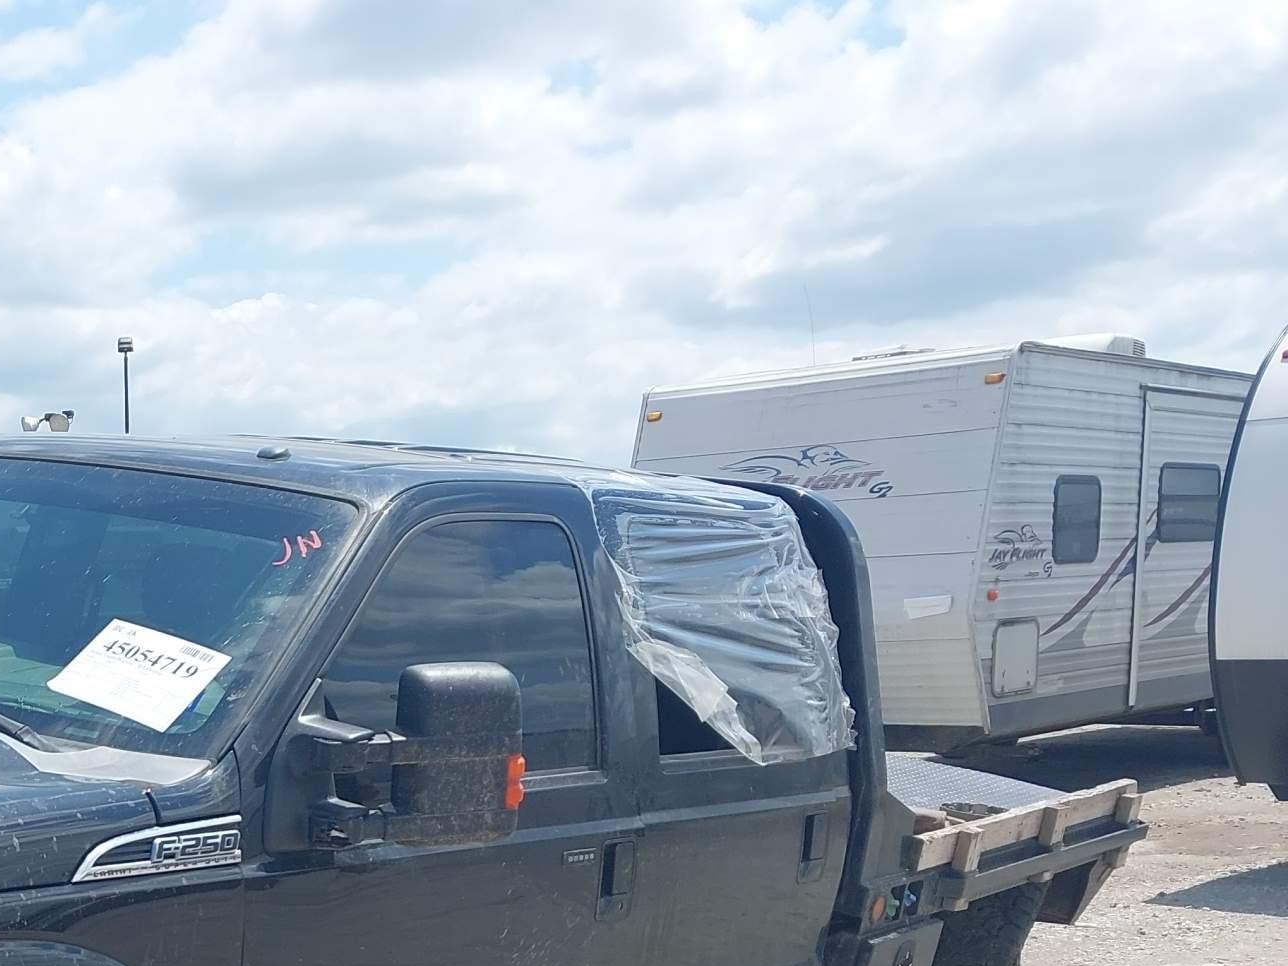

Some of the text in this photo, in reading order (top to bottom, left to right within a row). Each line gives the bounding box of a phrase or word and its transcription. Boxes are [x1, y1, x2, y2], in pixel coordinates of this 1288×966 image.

[988, 547, 1047, 562] JAY FLIGHT
[103, 639, 199, 678] 45054719
[151, 829, 241, 864] F-250
